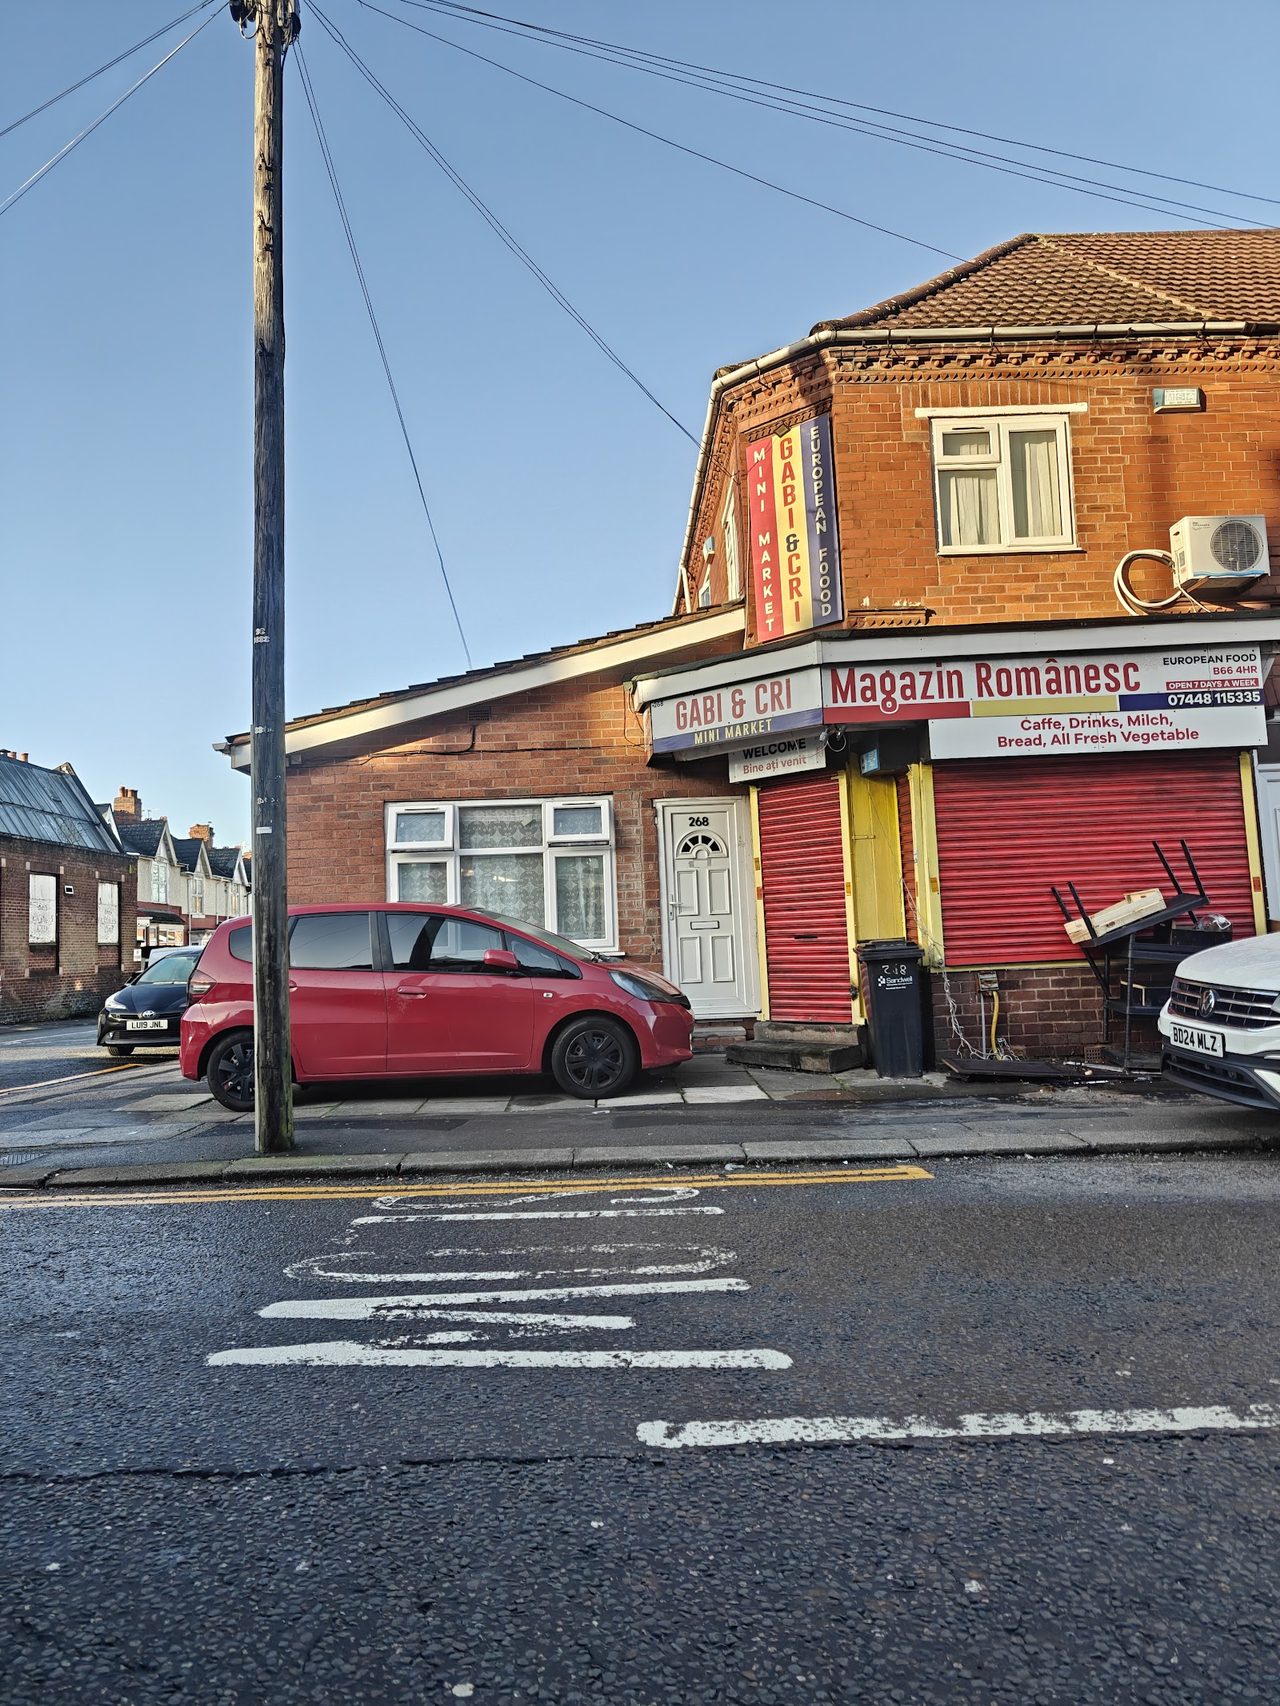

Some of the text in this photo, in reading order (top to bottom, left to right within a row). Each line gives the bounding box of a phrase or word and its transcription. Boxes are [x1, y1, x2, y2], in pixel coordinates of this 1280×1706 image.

[780, 437, 802, 623] GABI & CRI
[810, 426, 831, 617] EUROPEAN FOOD
[754, 448, 774, 632] MINI MARKET
[1163, 654, 1257, 666] EUROPEAN FOOD
[1214, 666, 1257, 675] B66 4HR
[830, 659, 1140, 714] Magazin Românesc
[1200, 680, 1222, 688] DAYS
[1231, 679, 1256, 687] WEEK
[676, 678, 792, 730] GABI & CRI
[1168, 692, 1260, 706] 07448 115335
[694, 719, 772, 744] MINI MARKET
[1021, 713, 1173, 732] Caffe, Drinks, Milch,
[998, 728, 1199, 748] Bread, All Fresh Vegetable
[743, 738, 806, 759] WELCOME
[743, 762, 763, 775] Bine
[780, 756, 807, 768] venit
[688, 816, 709, 826] 268
[131, 1021, 148, 1029] LU19
[1173, 1026, 1218, 1052] BD24 MLZ
